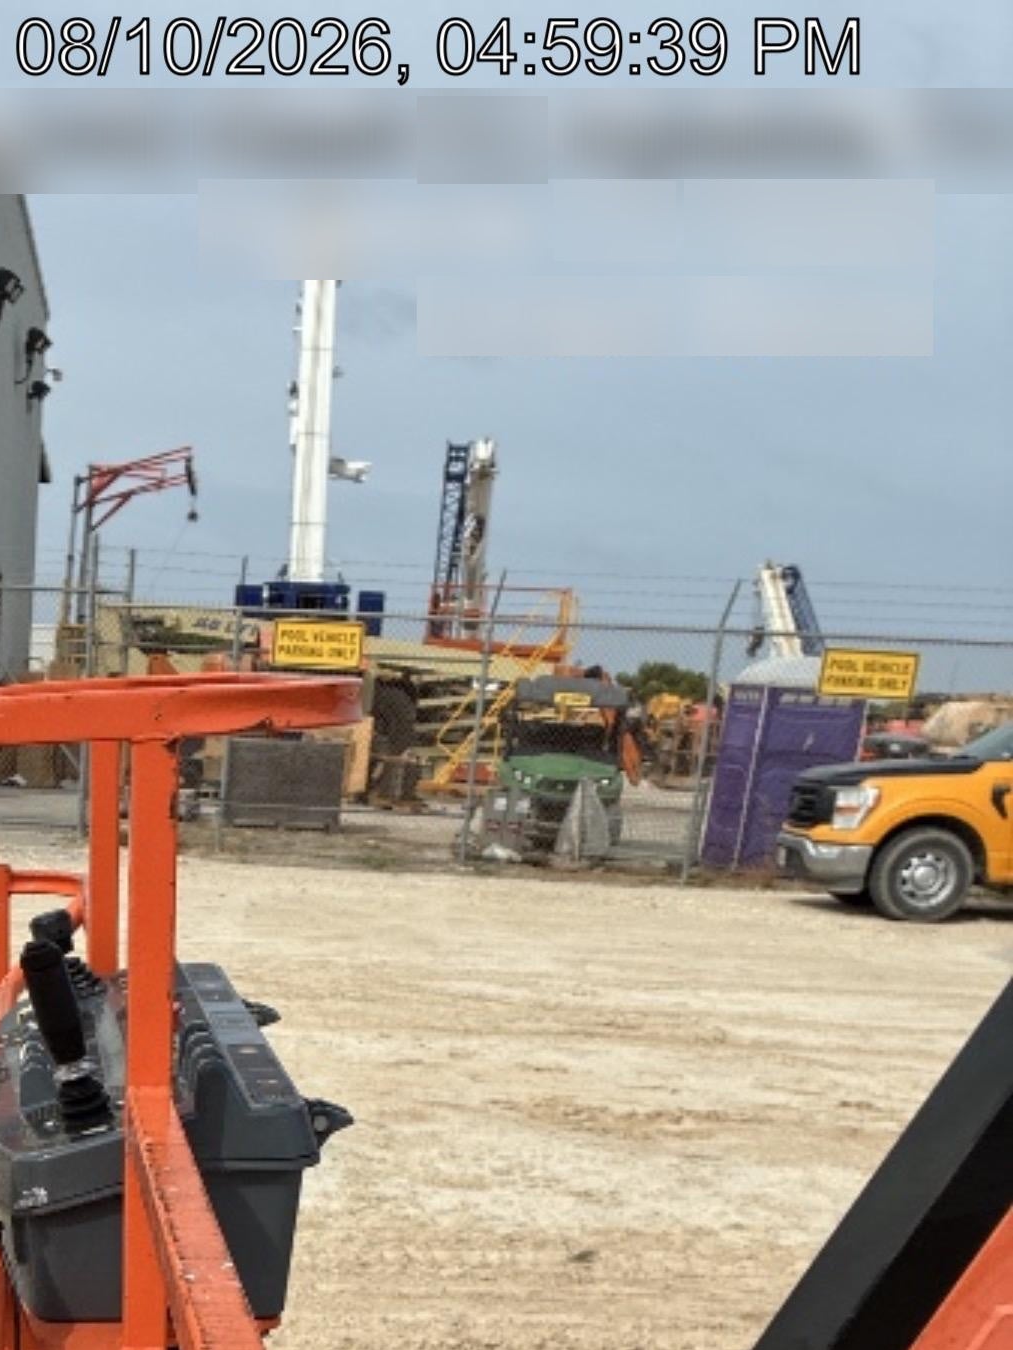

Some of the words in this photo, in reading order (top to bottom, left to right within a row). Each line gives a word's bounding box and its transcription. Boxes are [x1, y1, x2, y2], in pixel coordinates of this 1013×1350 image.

[280, 629, 308, 642] POOL
[313, 631, 357, 645] VEHICLE
[277, 645, 324, 658] PARKING
[329, 647, 357, 660] ONLY
[829, 658, 859, 673] POOL
[863, 660, 912, 675] VEHICLE
[826, 674, 873, 688] PARKING
[878, 677, 907, 690] ONLY
